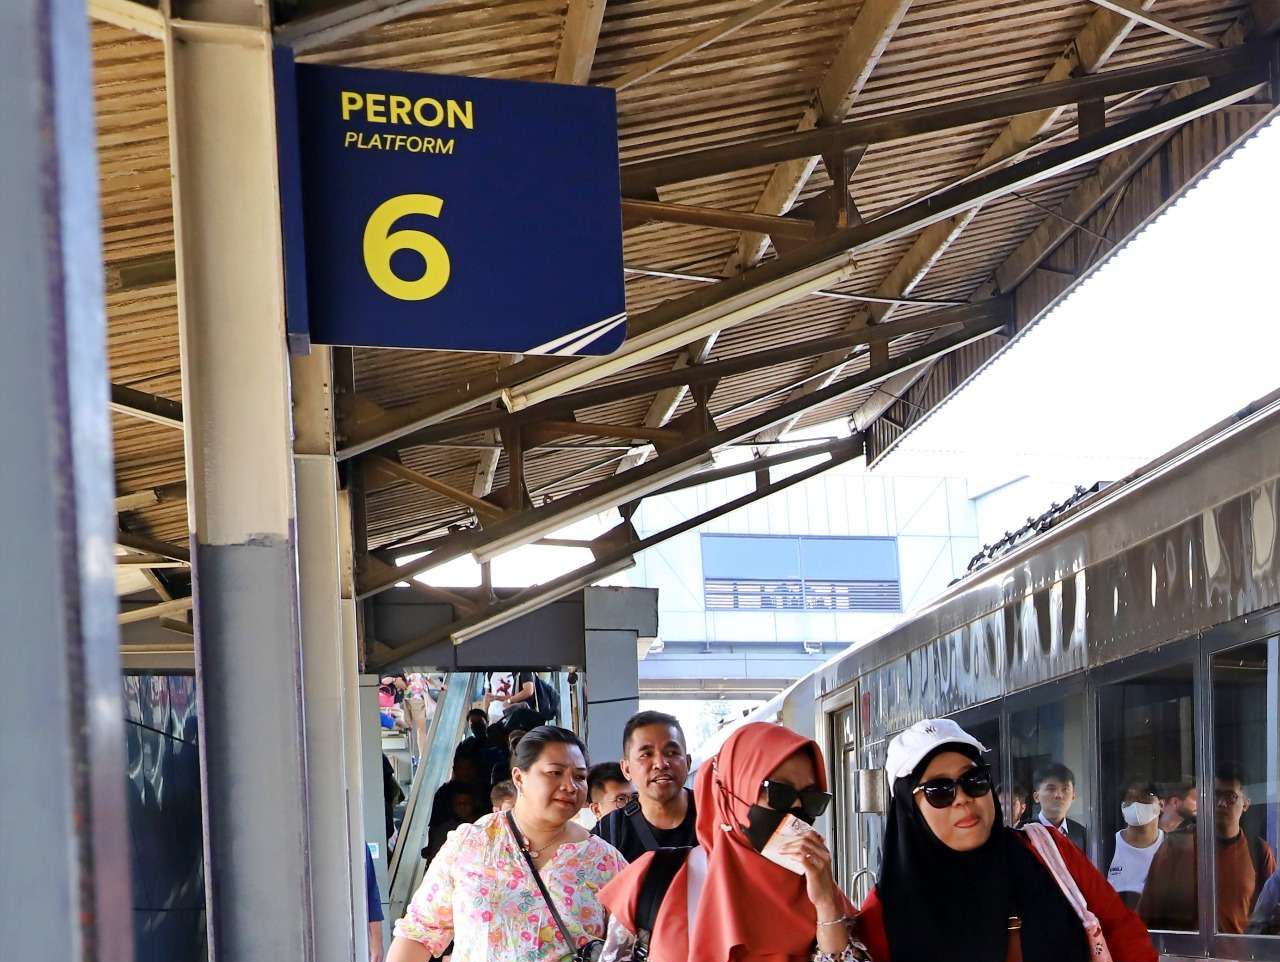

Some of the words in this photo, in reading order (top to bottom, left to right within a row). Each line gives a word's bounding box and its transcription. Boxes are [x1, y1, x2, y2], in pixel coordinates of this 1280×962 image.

[341, 91, 474, 129] PERON
[344, 131, 455, 154] PLATFORM
[363, 193, 450, 301] 6
